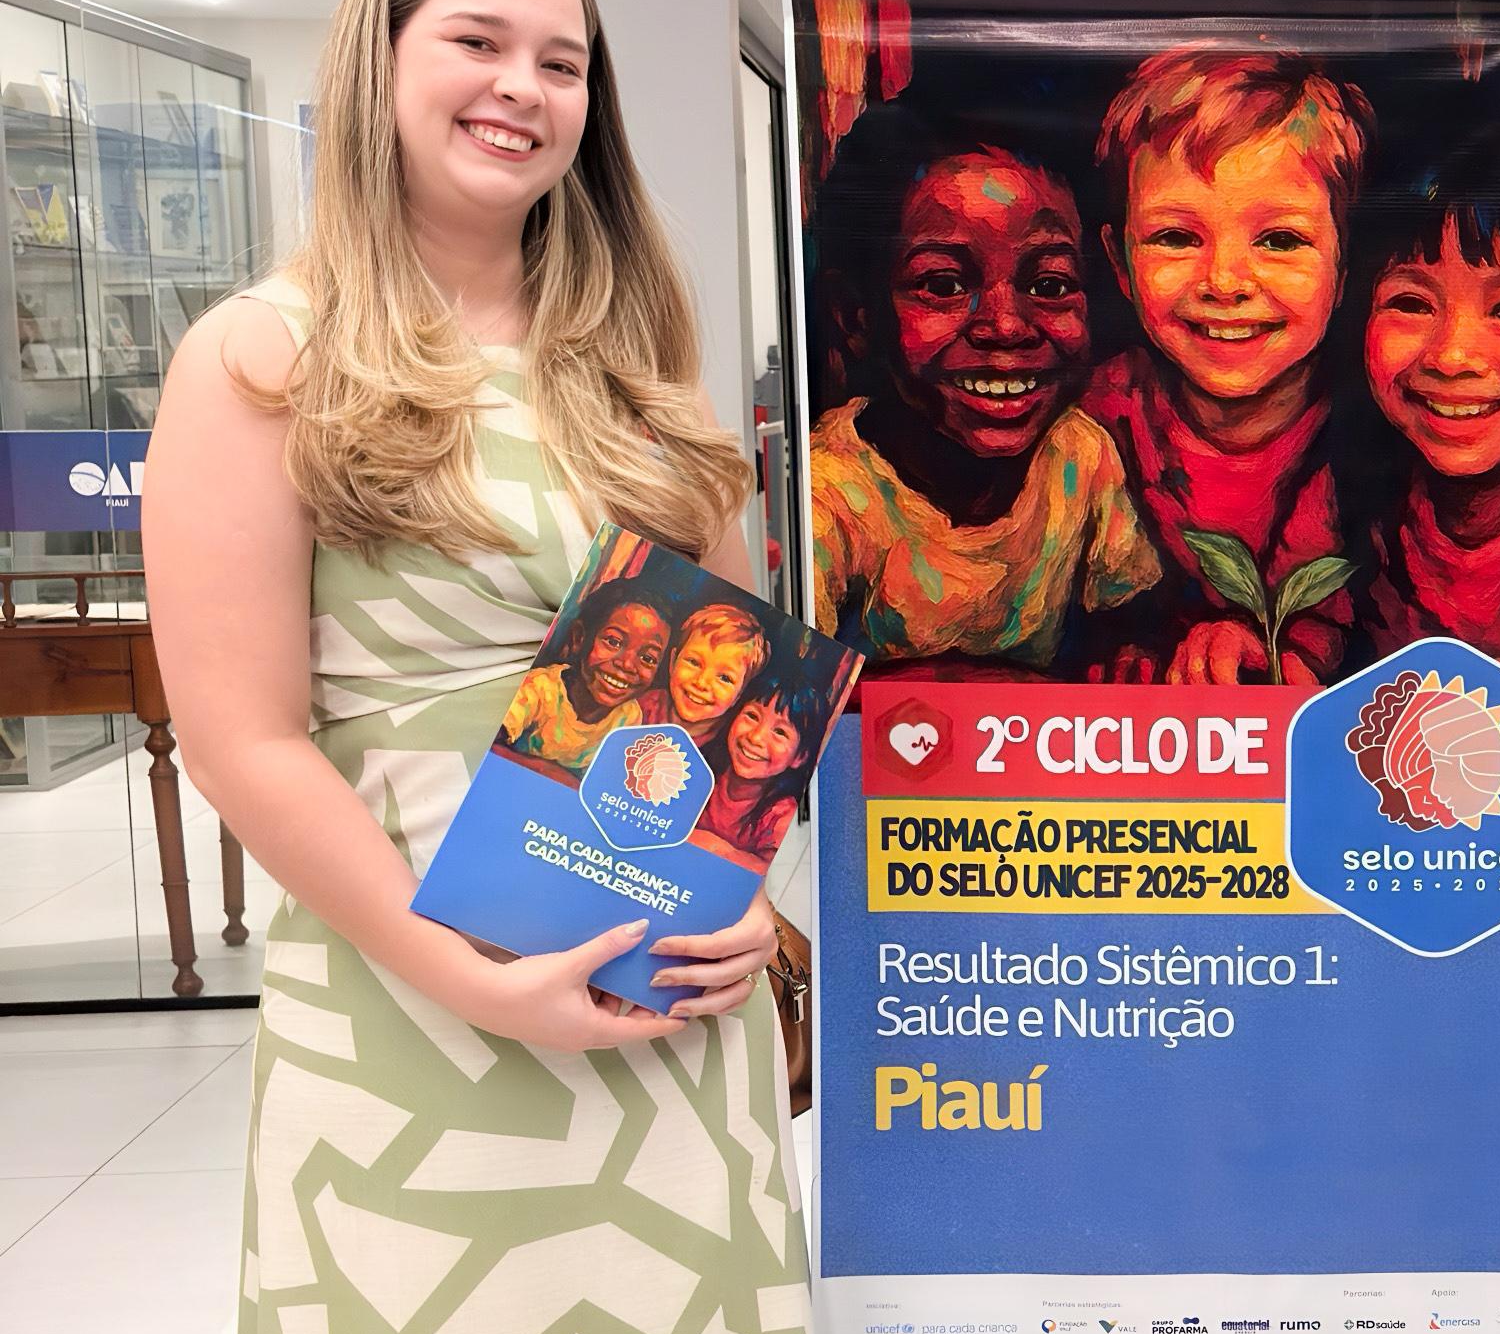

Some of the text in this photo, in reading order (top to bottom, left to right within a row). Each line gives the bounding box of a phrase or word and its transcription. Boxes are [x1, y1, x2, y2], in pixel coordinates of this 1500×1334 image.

[976, 715, 1268, 775] 2º CICLO DE
[600, 791, 673, 830] selo unicef
[880, 810, 1257, 863] FORMAÇÃO PRESENCIAL
[1343, 844, 1415, 870] selo
[523, 820, 693, 904] PARA CADA CRIANÇA E
[525, 840, 678, 916] CADA ADOLESCENTE
[888, 863, 933, 896] DO
[939, 863, 1018, 897] SELO
[1023, 865, 1132, 898] UNICEF
[878, 942, 1338, 986] Resultado Sistêmico 1:
[876, 994, 1235, 1048] Saúde e Nutrição
[875, 1062, 1049, 1131] Piauí
[866, 1323, 900, 1334] unicef
[949, 1323, 975, 1333] cada
[978, 1323, 1018, 1334] criança
[1152, 1326, 1208, 1334] PROFARMA
[1280, 1320, 1321, 1330] rumo
